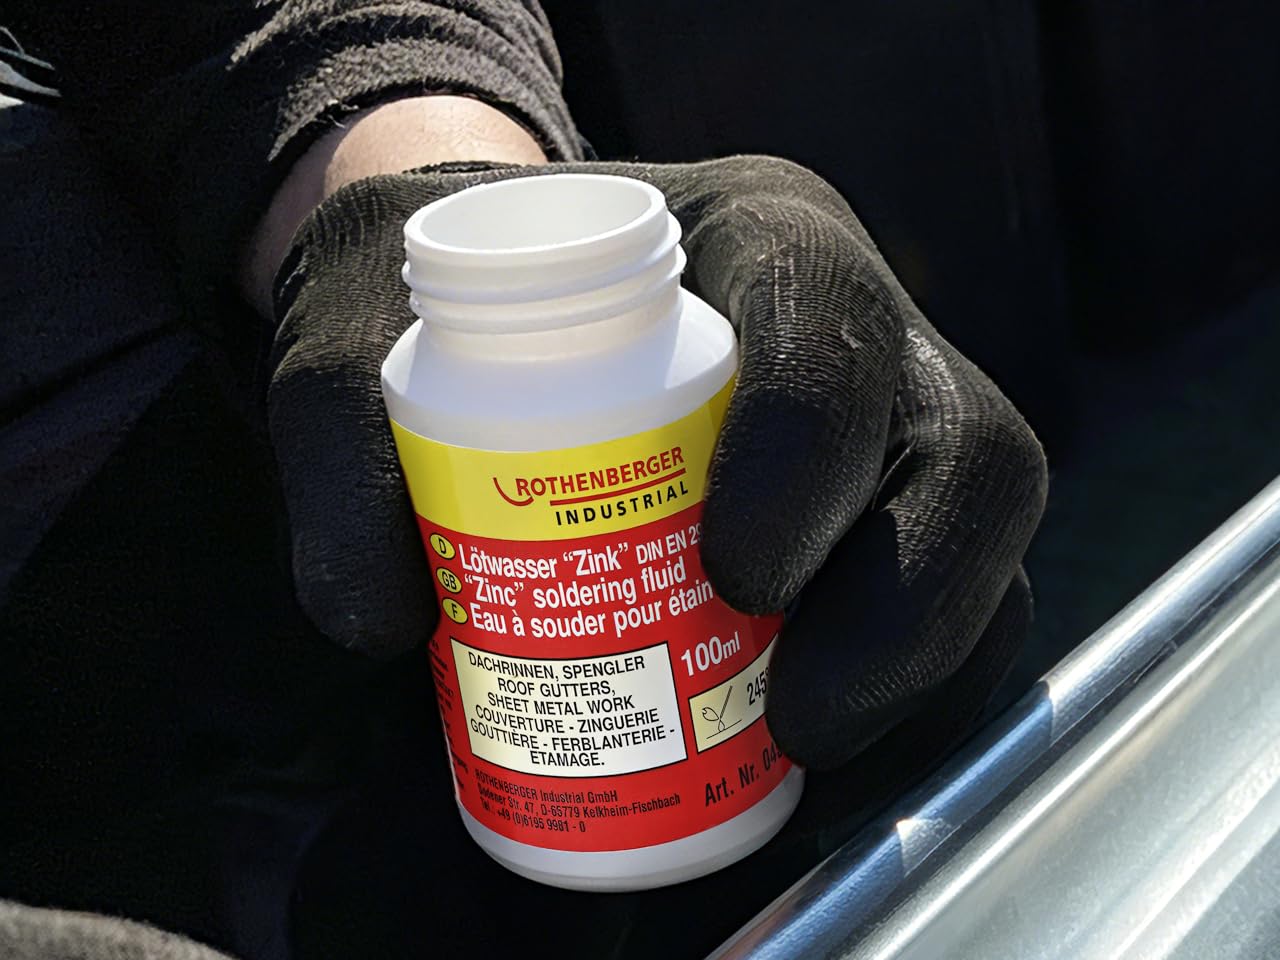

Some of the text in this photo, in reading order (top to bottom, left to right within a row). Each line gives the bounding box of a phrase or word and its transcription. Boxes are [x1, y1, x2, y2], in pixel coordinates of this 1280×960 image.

[514, 446, 685, 499] ROTHENBERGER
[555, 480, 689, 526] INDUSTRIAL
[438, 538, 447, 554] D
[458, 543, 558, 579] Lötwasser
[635, 538, 663, 565] DIN
[665, 529, 687, 555] EN
[441, 571, 457, 591] GB
[532, 577, 637, 609] soldering
[641, 555, 687, 594] fluid
[451, 603, 458, 619] F
[469, 578, 714, 639] Eau à souder pour étain
[468, 651, 646, 681] DACHRINNEN, SPENGLER
[680, 631, 741, 677] 100ml
[497, 677, 616, 698] ROOF GUTTERS,
[475, 704, 565, 734] COUVERTURE
[577, 708, 660, 734] ZINGUERIE
[487, 692, 636, 716] SHEET METAL WORK
[470, 719, 540, 750] GOUTTIÈRE
[551, 725, 666, 752] FERBLANTERIE
[529, 750, 606, 767] ETAMAGE.
[540, 789, 585, 804] Industrial
[587, 790, 618, 804] GmbH
[705, 777, 734, 807] Art.
[738, 762, 760, 789] Nr.
